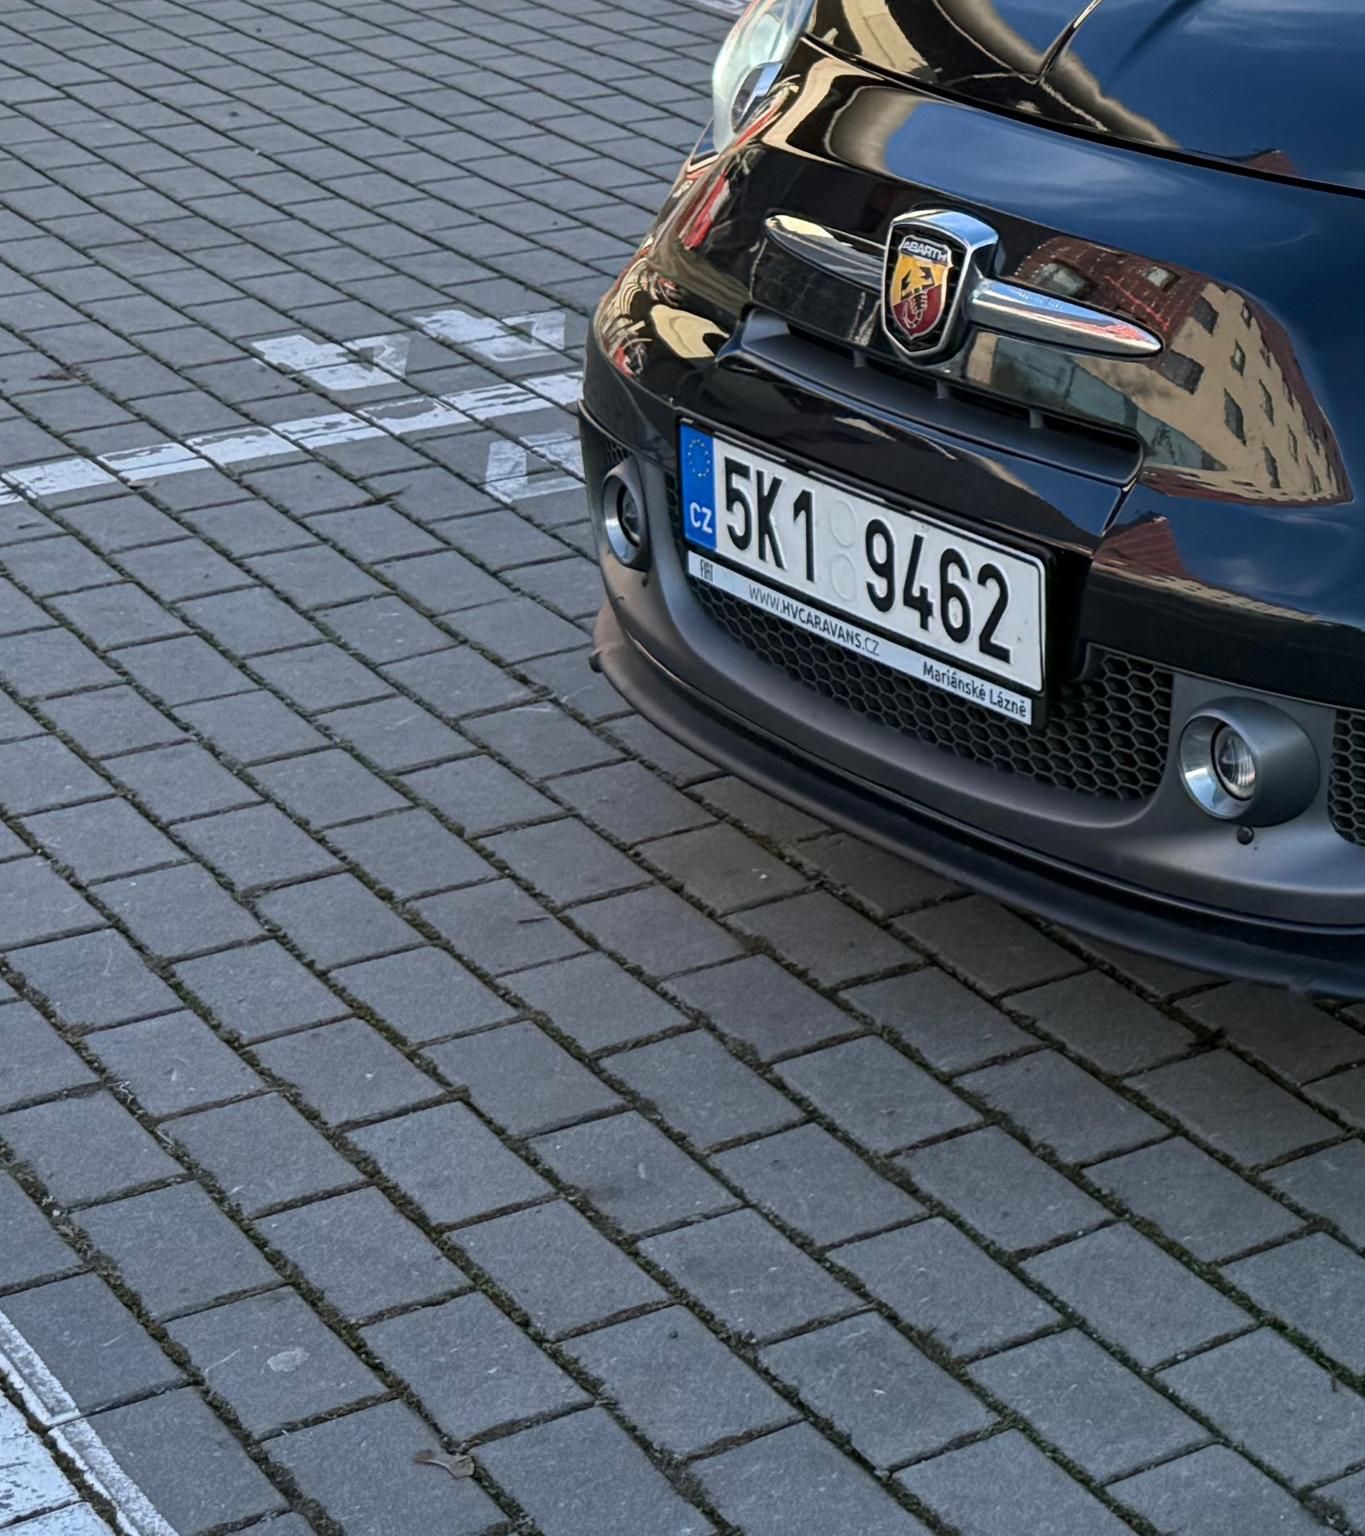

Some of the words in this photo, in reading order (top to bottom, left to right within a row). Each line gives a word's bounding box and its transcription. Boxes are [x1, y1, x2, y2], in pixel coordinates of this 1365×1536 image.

[903, 240, 947, 262] ABARTH
[690, 502, 713, 534] CZ
[724, 456, 815, 583] 5K1
[865, 518, 1011, 664] 9462
[748, 584, 880, 656] WWW.HVCARAVANS.CZ
[923, 661, 986, 701] Mariánské
[989, 688, 1026, 717] Lázně
